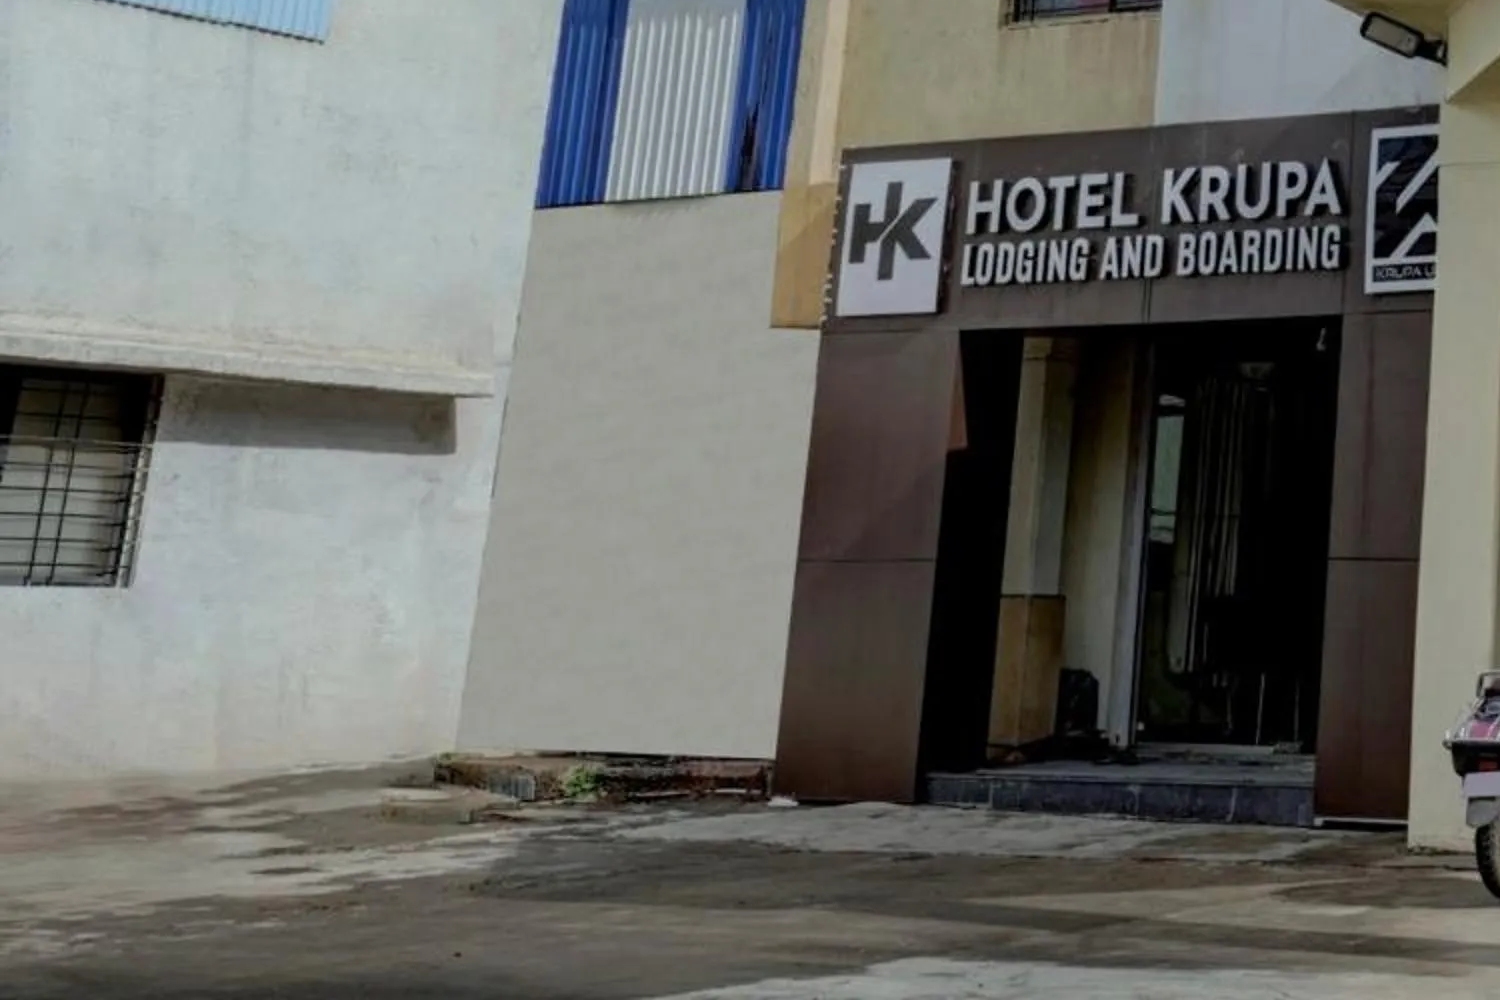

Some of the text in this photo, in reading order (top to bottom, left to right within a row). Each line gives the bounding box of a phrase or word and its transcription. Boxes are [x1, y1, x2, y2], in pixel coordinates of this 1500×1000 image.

[965, 156, 1342, 235] HOTEL KRUPA
[960, 224, 1342, 287] LODGING AND BOARDING
